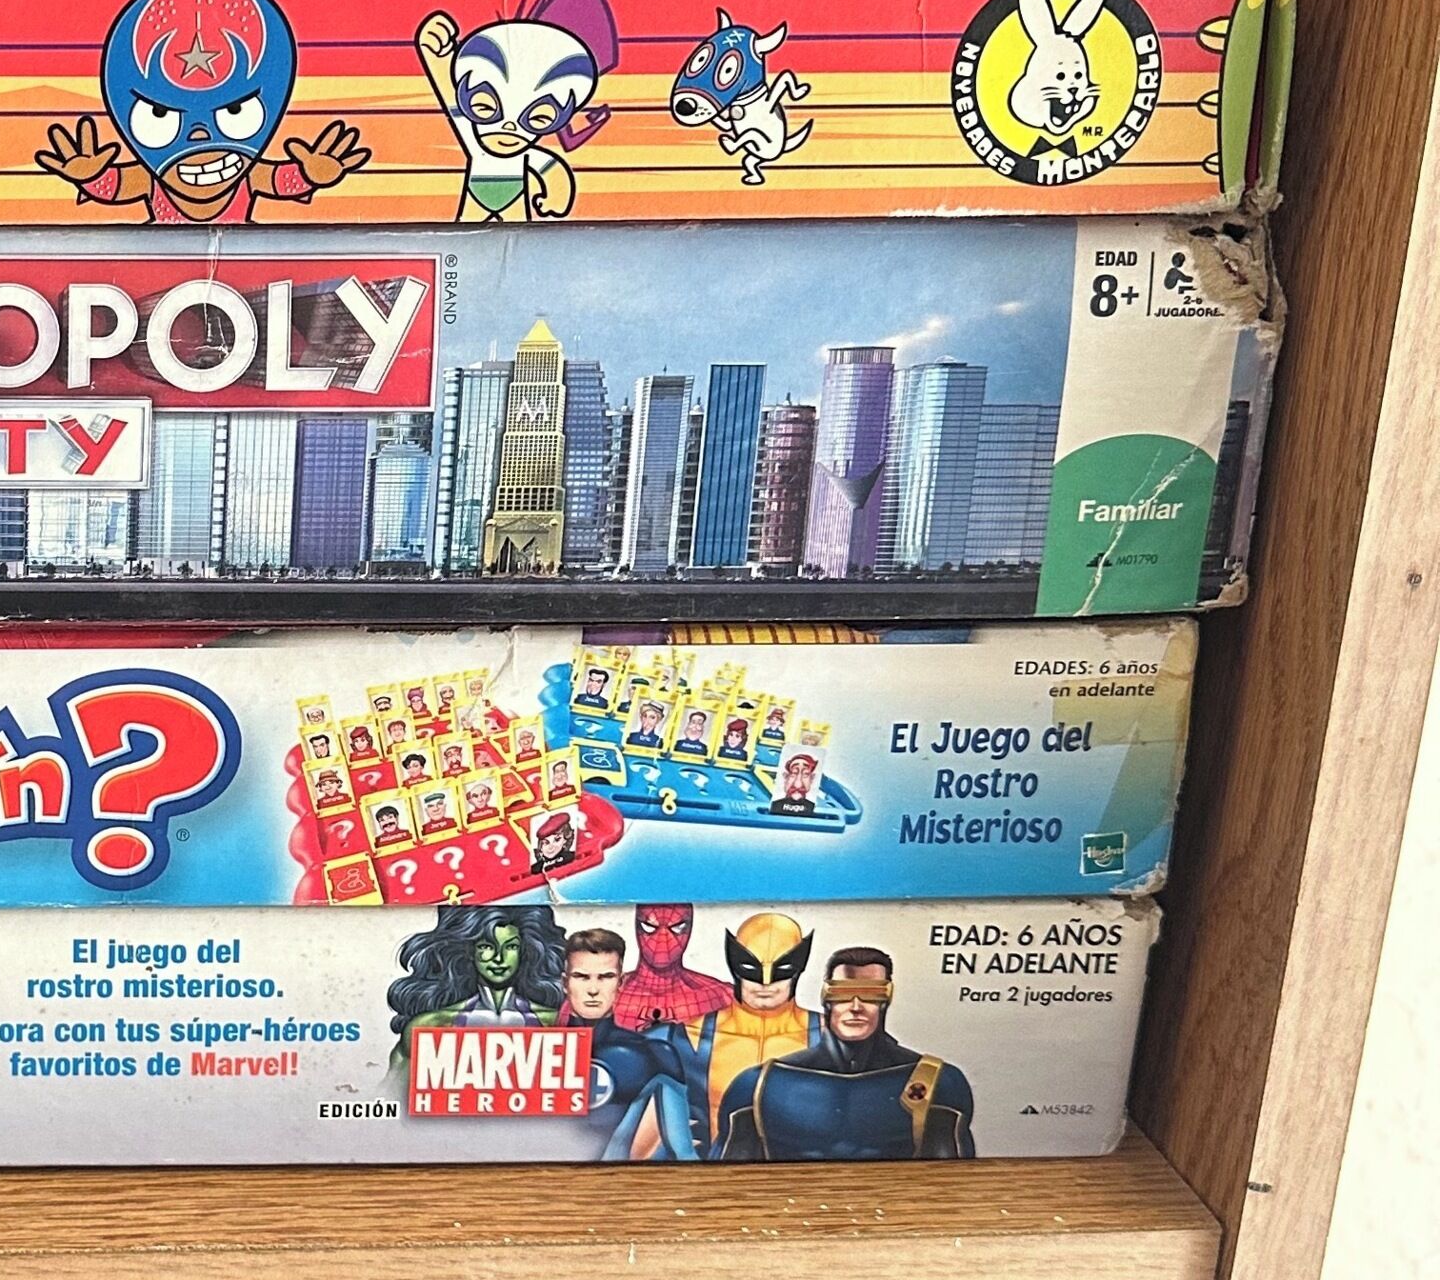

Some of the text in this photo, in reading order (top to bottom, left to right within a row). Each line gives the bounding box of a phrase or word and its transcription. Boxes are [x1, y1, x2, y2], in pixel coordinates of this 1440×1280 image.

[1033, 33, 1159, 185] MONTECARLO
[1095, 251, 1137, 266] EDAD
[444, 270, 456, 325] BRAND
[1089, 274, 1140, 317] 8+
[1077, 499, 1184, 522] Familiar
[1014, 660, 1158, 675] EDADES: 6 años
[1048, 681, 1155, 697] en adelante
[891, 722, 1092, 760] El Juego del
[934, 768, 1038, 799] Rostro
[899, 809, 1062, 844] Misterioso
[929, 918, 1122, 946] EDAD: 6 AÑOS
[72, 939, 240, 969] El juego del
[941, 953, 1118, 974] EN ADELANTE
[27, 974, 284, 999] rostro misterioso.
[959, 985, 1113, 1006] Para 2 jugadores
[54, 1023, 106, 1042] con
[115, 1020, 160, 1042] tus
[170, 1017, 360, 1047] súper-héroes
[10, 1051, 298, 1076] favoritos de Marvel!
[416, 1031, 585, 1091] MARVEL
[319, 1099, 398, 1118] EDICIÓN
[415, 1092, 585, 1112] HEROES
